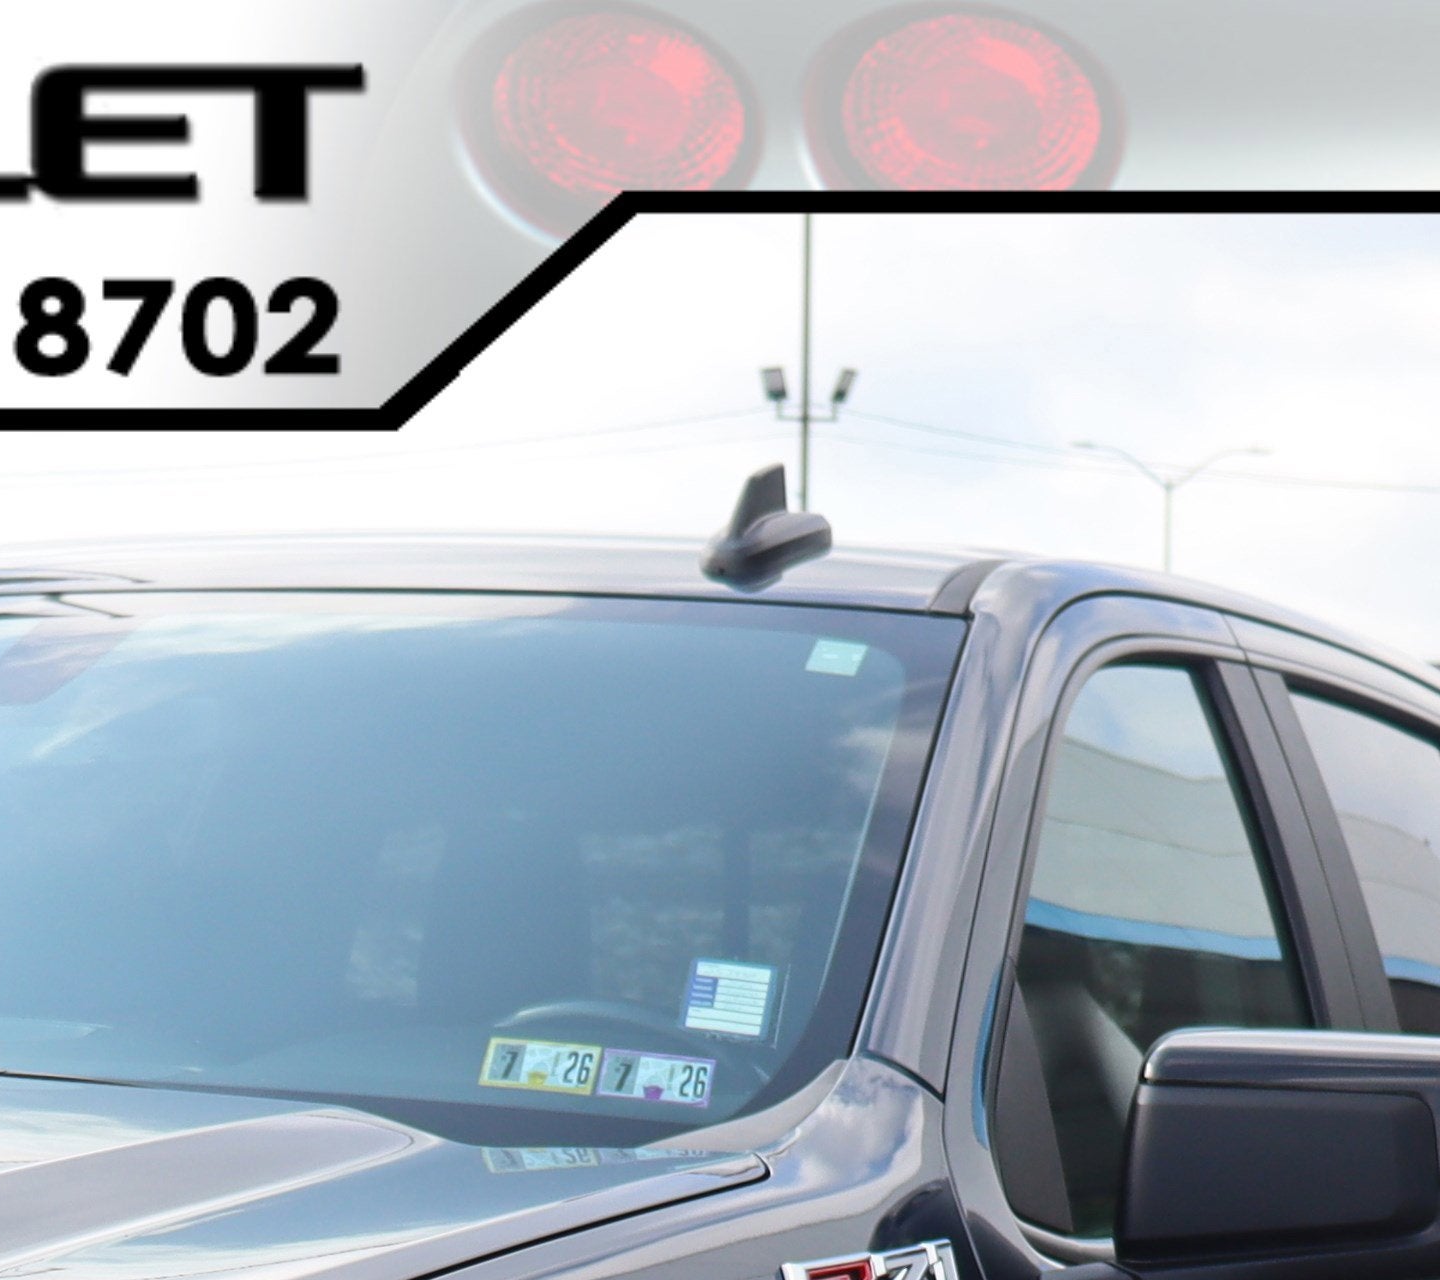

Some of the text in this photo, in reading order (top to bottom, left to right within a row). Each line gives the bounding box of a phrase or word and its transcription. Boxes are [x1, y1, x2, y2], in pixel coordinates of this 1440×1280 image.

[500, 1050, 594, 1086] 7 26
[613, 1062, 709, 1099] 7 26
